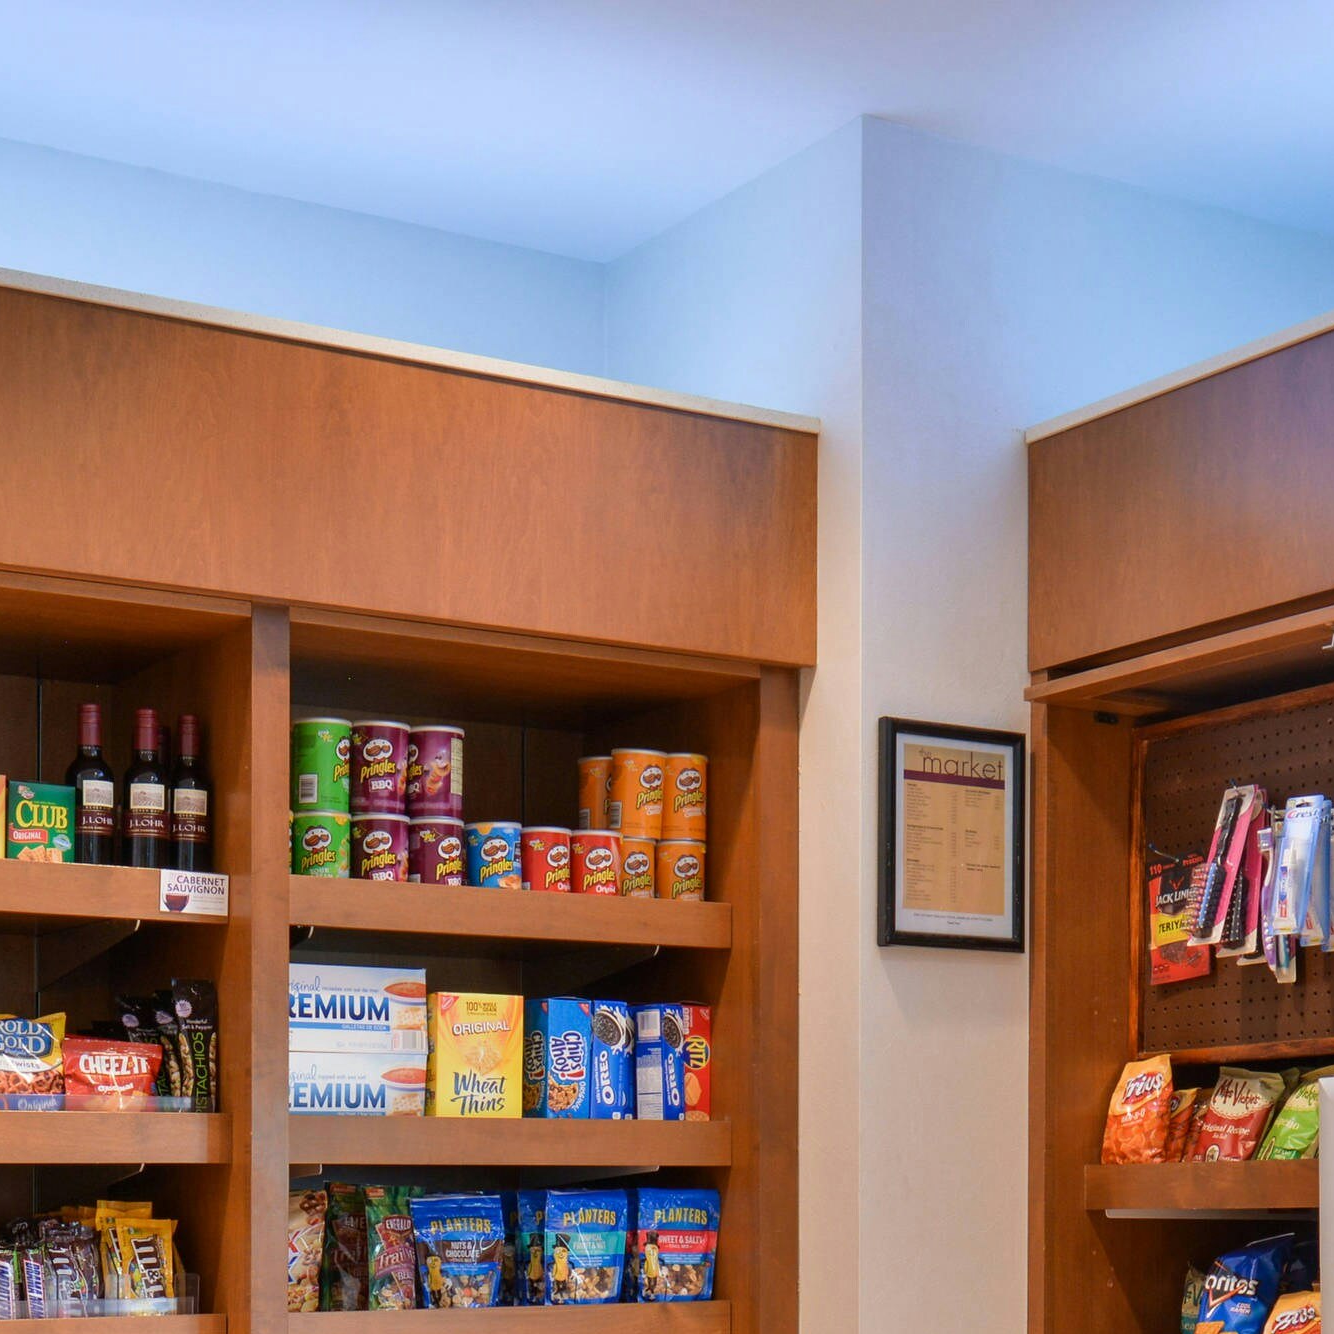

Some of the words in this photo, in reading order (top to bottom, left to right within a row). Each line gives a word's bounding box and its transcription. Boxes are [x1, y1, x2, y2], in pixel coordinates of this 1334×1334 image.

[360, 760, 396, 783] Pringles
[922, 752, 1004, 781] market
[371, 779, 393, 790] BBQ
[16, 801, 68, 828] CLUB
[1286, 809, 1320, 819] Crest
[13, 830, 42, 840] ORIGINAL
[301, 849, 336, 871] Pringles
[362, 853, 396, 876] Pringles
[177, 875, 225, 886] CABERNET
[372, 871, 394, 881] BBQ
[480, 859, 513, 884] Pringles
[583, 870, 615, 891] Pringles
[167, 883, 225, 895] SAUVIGNON
[452, 1020, 511, 1036] ORIGINAL
[564, 1032, 581, 1071] Chips
[691, 1037, 705, 1067] RITZ
[453, 1072, 506, 1096] Wheat
[599, 1051, 614, 1105] OREO
[668, 1053, 680, 1106] OREO
[451, 1095, 506, 1115] Thins
[431, 1219, 491, 1233] PLANTERS
[563, 1209, 616, 1226] PLANTERS
[654, 1209, 707, 1224] PLANTERS
